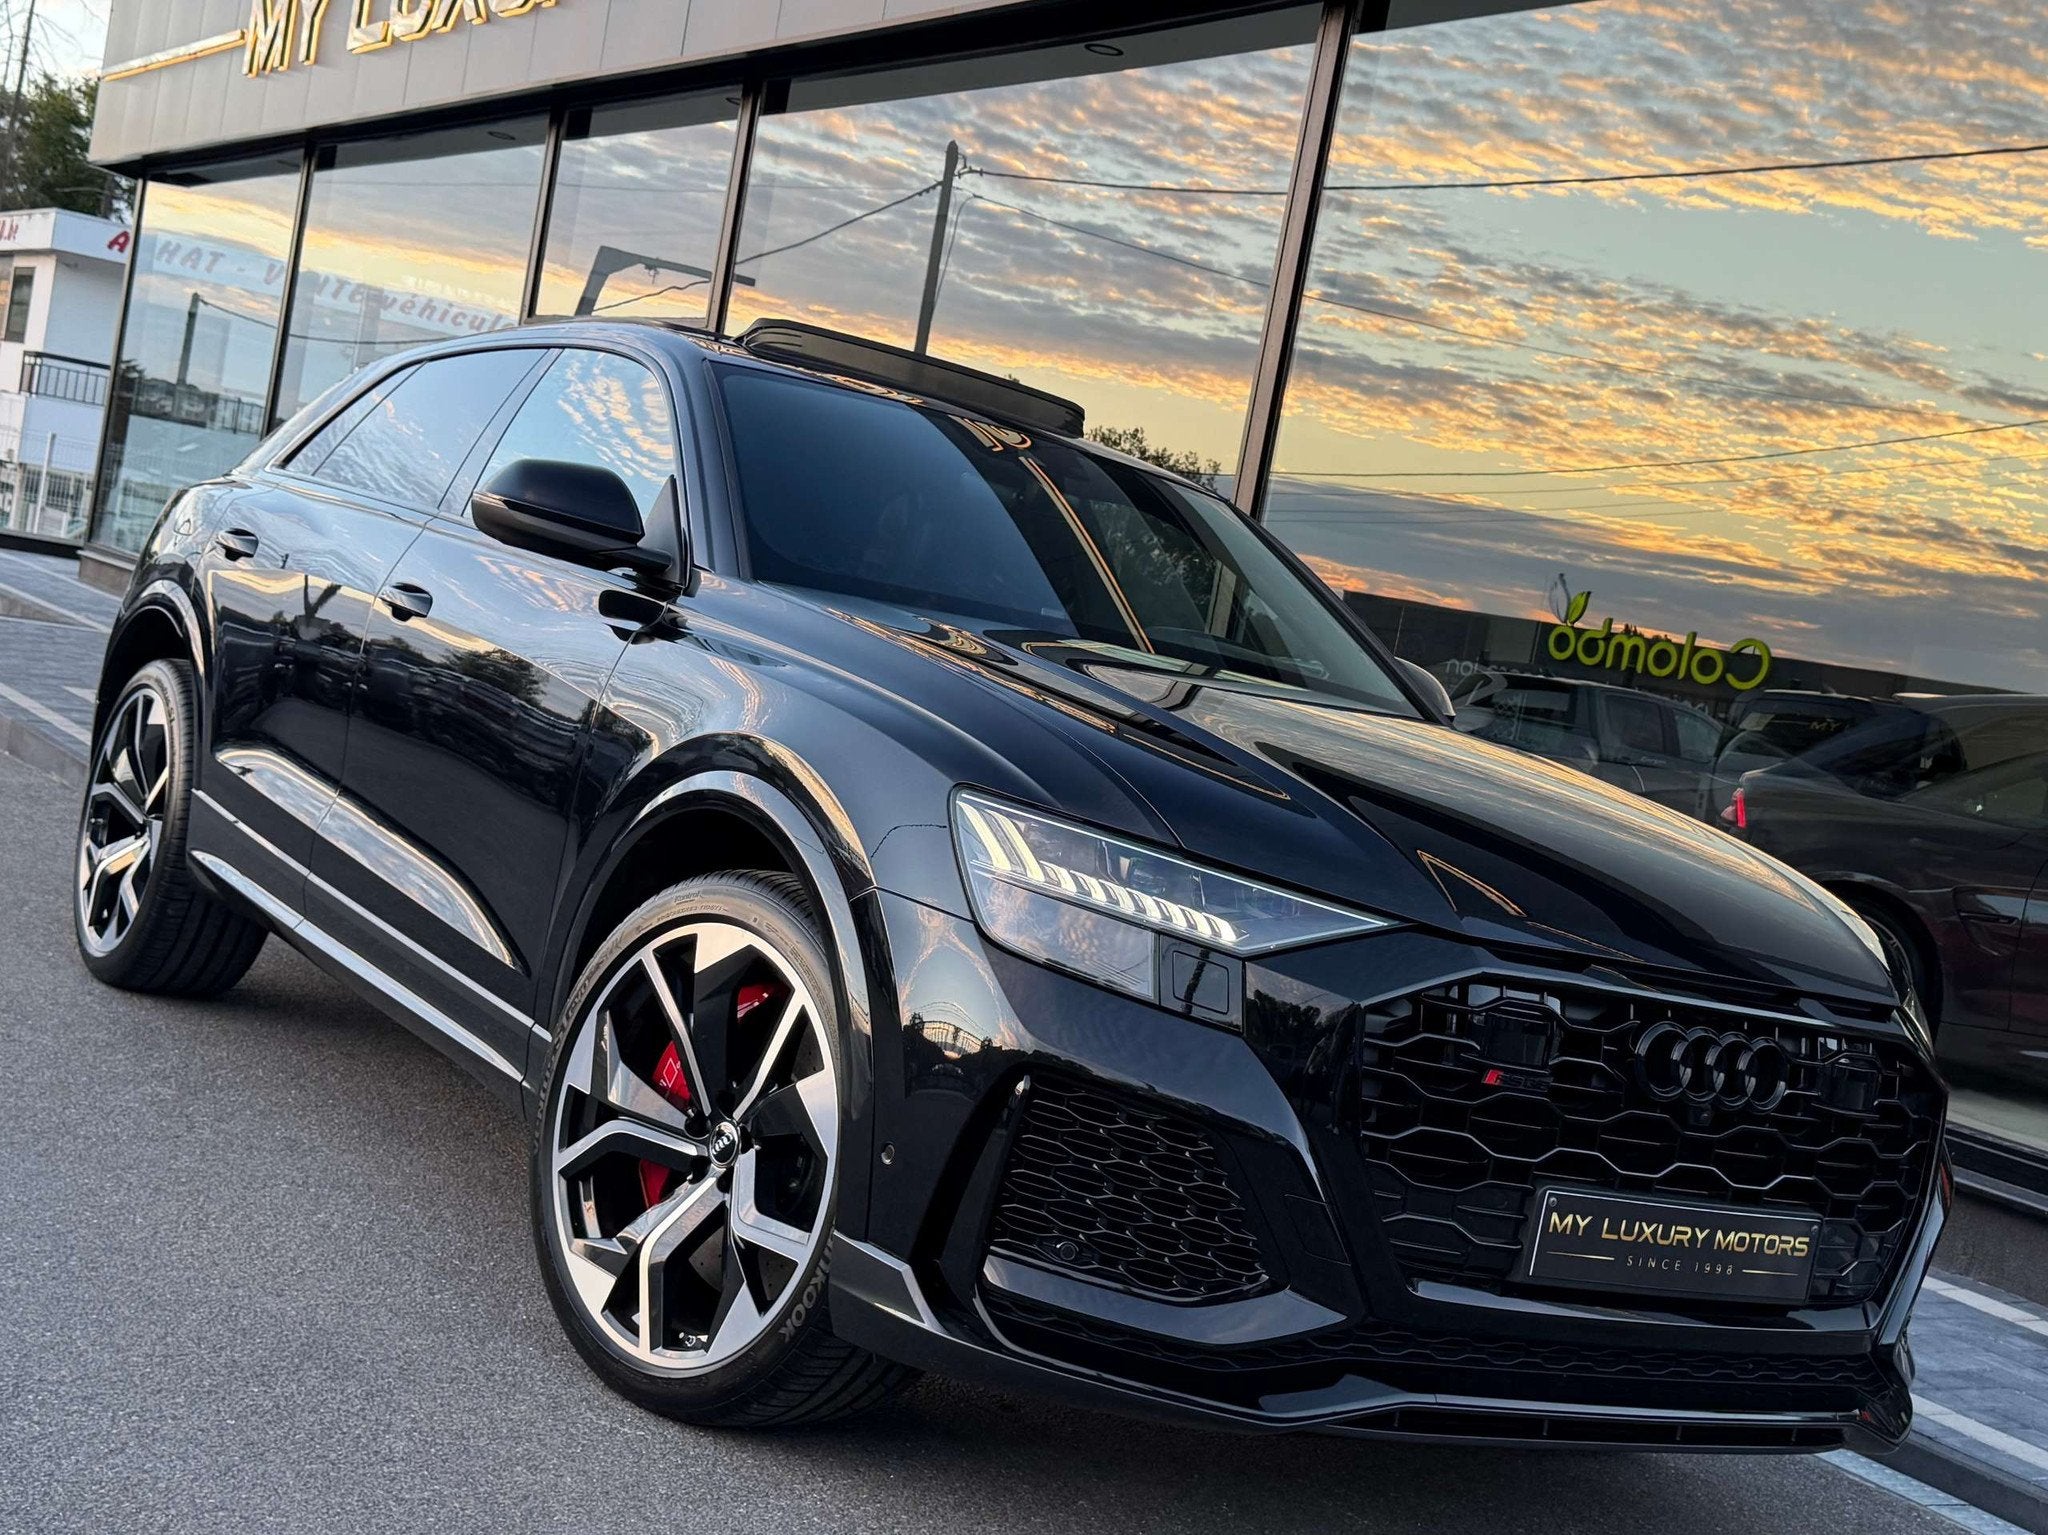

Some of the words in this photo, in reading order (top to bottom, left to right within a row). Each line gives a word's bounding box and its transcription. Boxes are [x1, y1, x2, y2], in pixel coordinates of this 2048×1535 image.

[242, 0, 329, 78] MY
[1548, 1211, 1593, 1237] MY
[1601, 1217, 1710, 1249] LUXURY
[1714, 1229, 1810, 1257] MOTORS
[1626, 1255, 1681, 1272] SINCE
[1694, 1261, 1734, 1276] 1998
